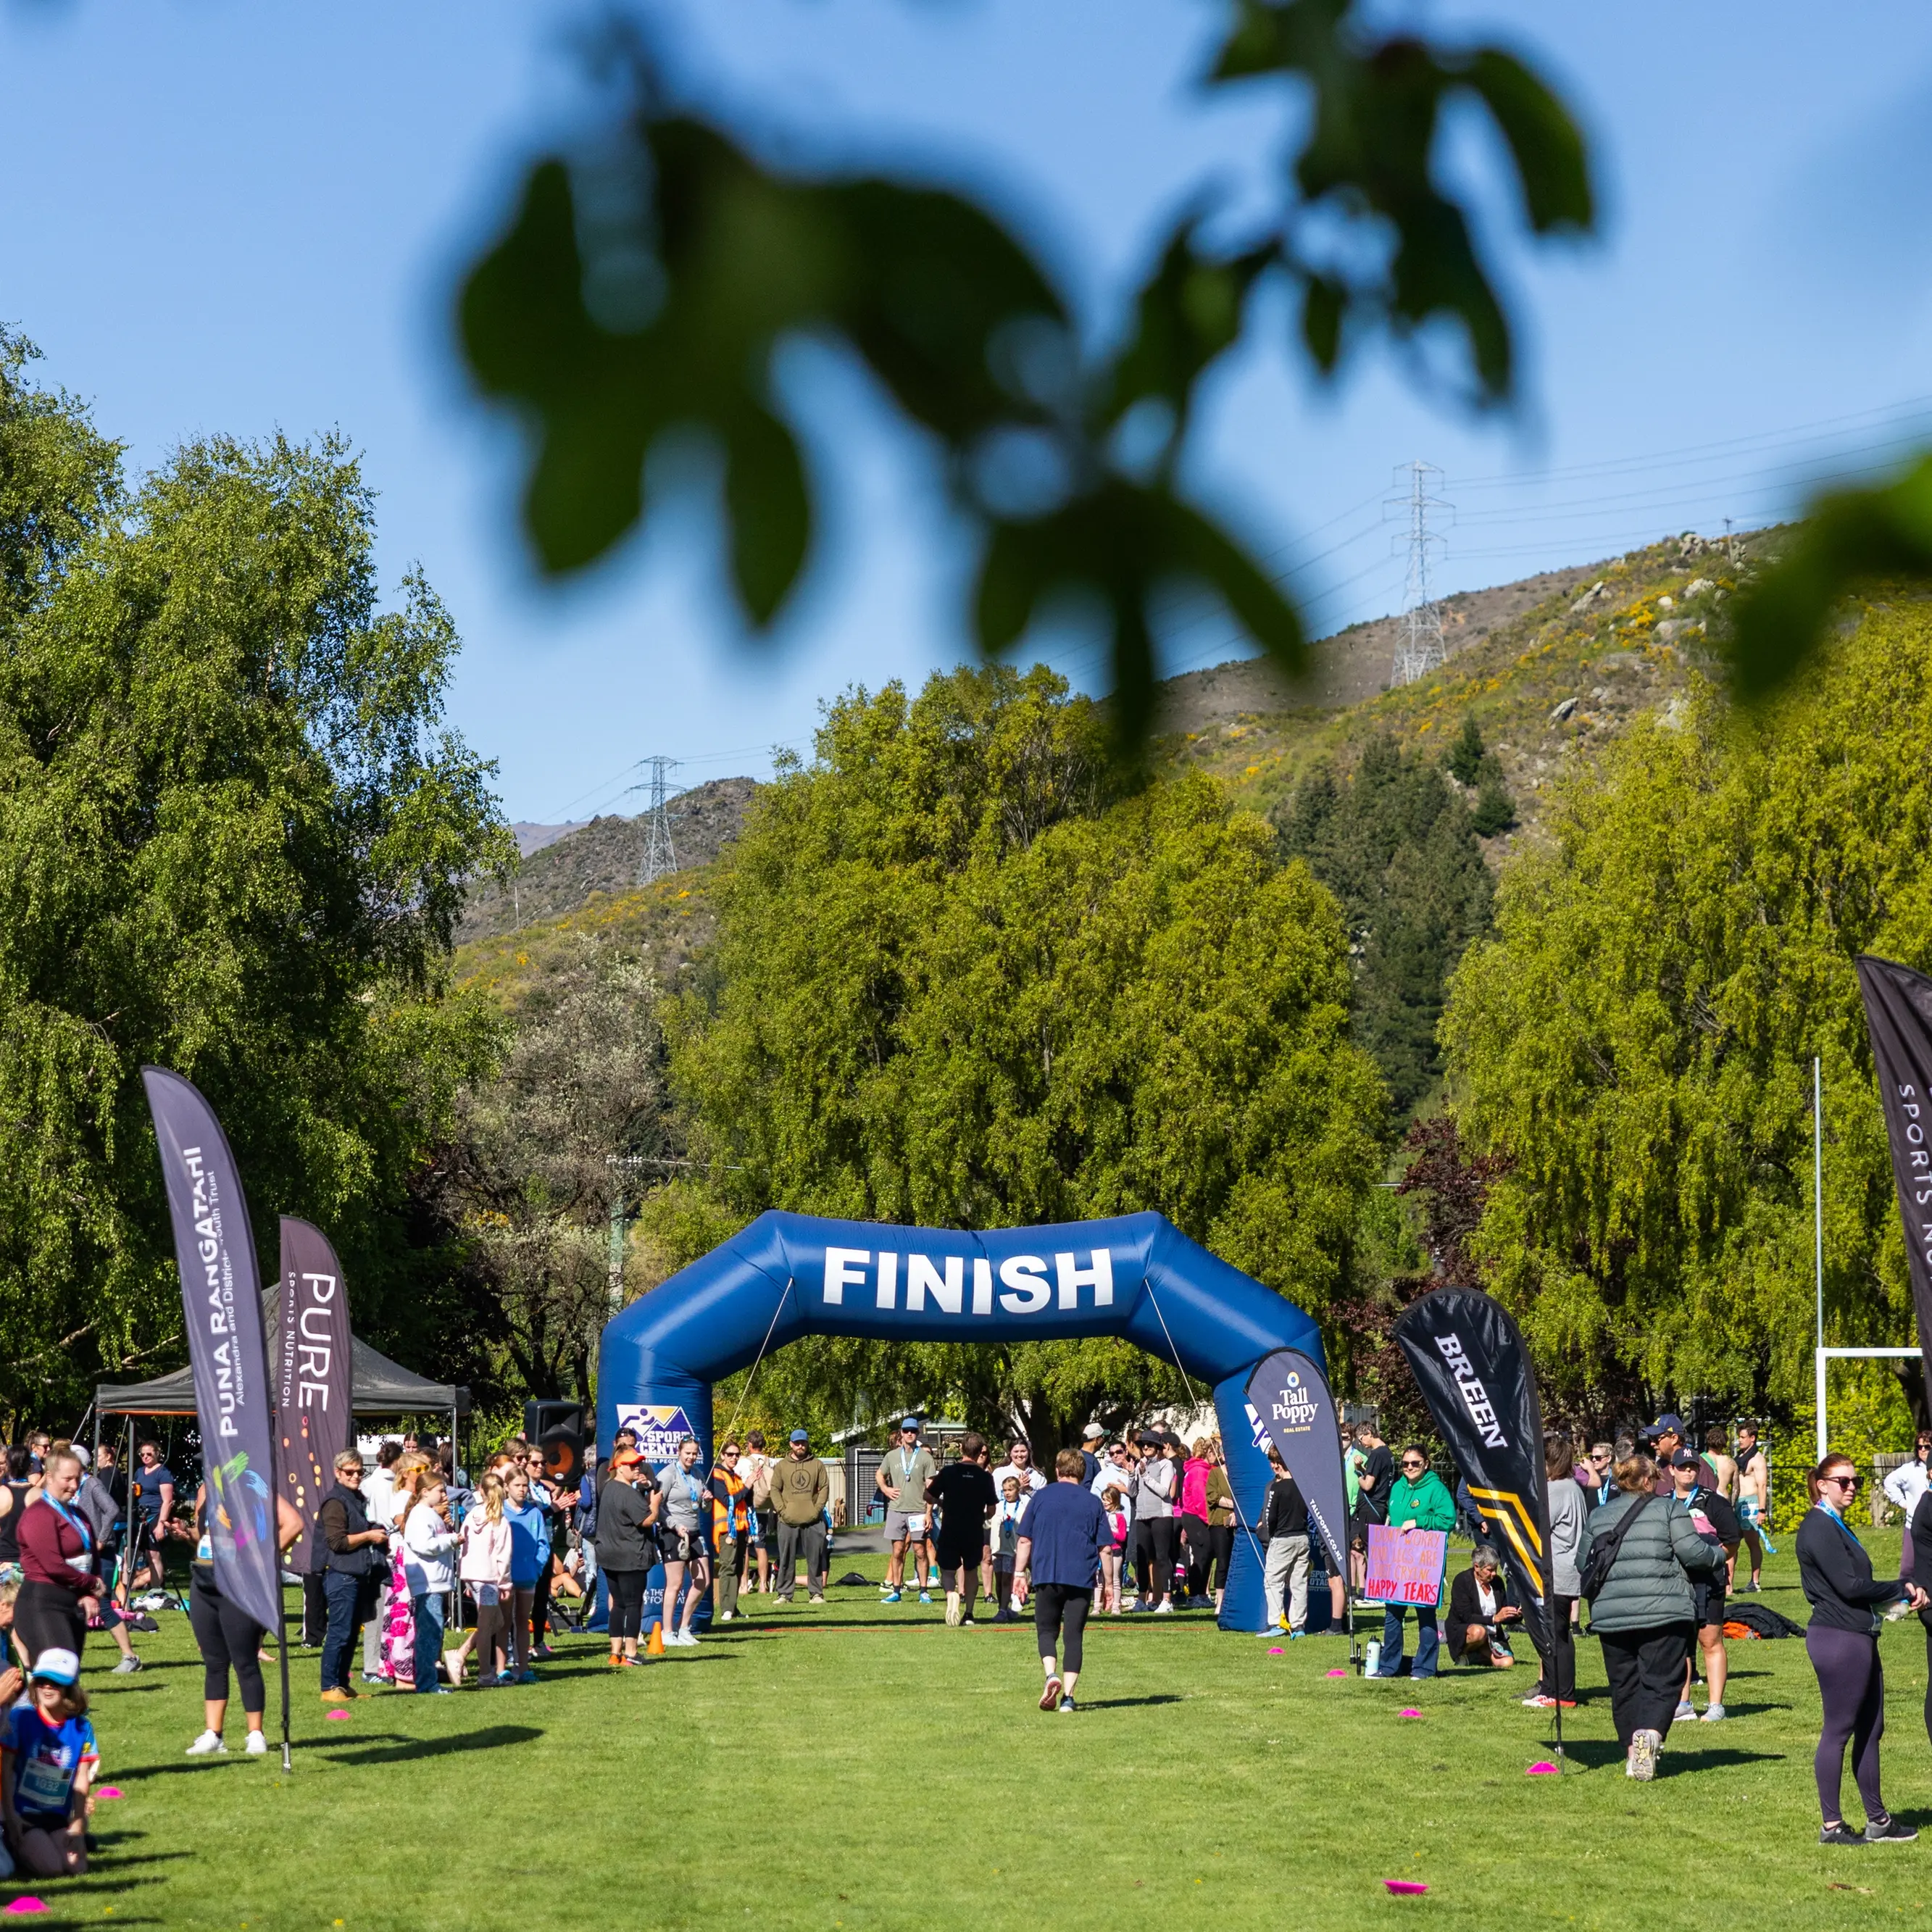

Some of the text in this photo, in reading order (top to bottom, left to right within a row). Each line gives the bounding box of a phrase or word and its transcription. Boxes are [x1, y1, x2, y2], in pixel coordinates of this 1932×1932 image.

[1899, 1084, 1932, 1205] SPORTS
[207, 1170, 220, 1207] Trust
[183, 1146, 238, 1438] PUNA RANGATAHI
[823, 1246, 1113, 1315] FINISH
[225, 1307, 236, 1333] and
[297, 1273, 336, 1412] PURE
[232, 1336, 245, 1407] Alexandra
[282, 1331, 296, 1407] NUTRITION
[1280, 1386, 1309, 1406] Tall
[1434, 1333, 1509, 1449] BREEN
[1272, 1403, 1319, 1424] Poppy
[1309, 1499, 1343, 1562] TALLPOPPY.CO.NZ
[1392, 1547, 1414, 1564] LEGS
[1418, 1550, 1438, 1567] ARE
[1309, 1578, 1328, 1586] OTAG
[1367, 1578, 1438, 1604] HAPPY TEARS
